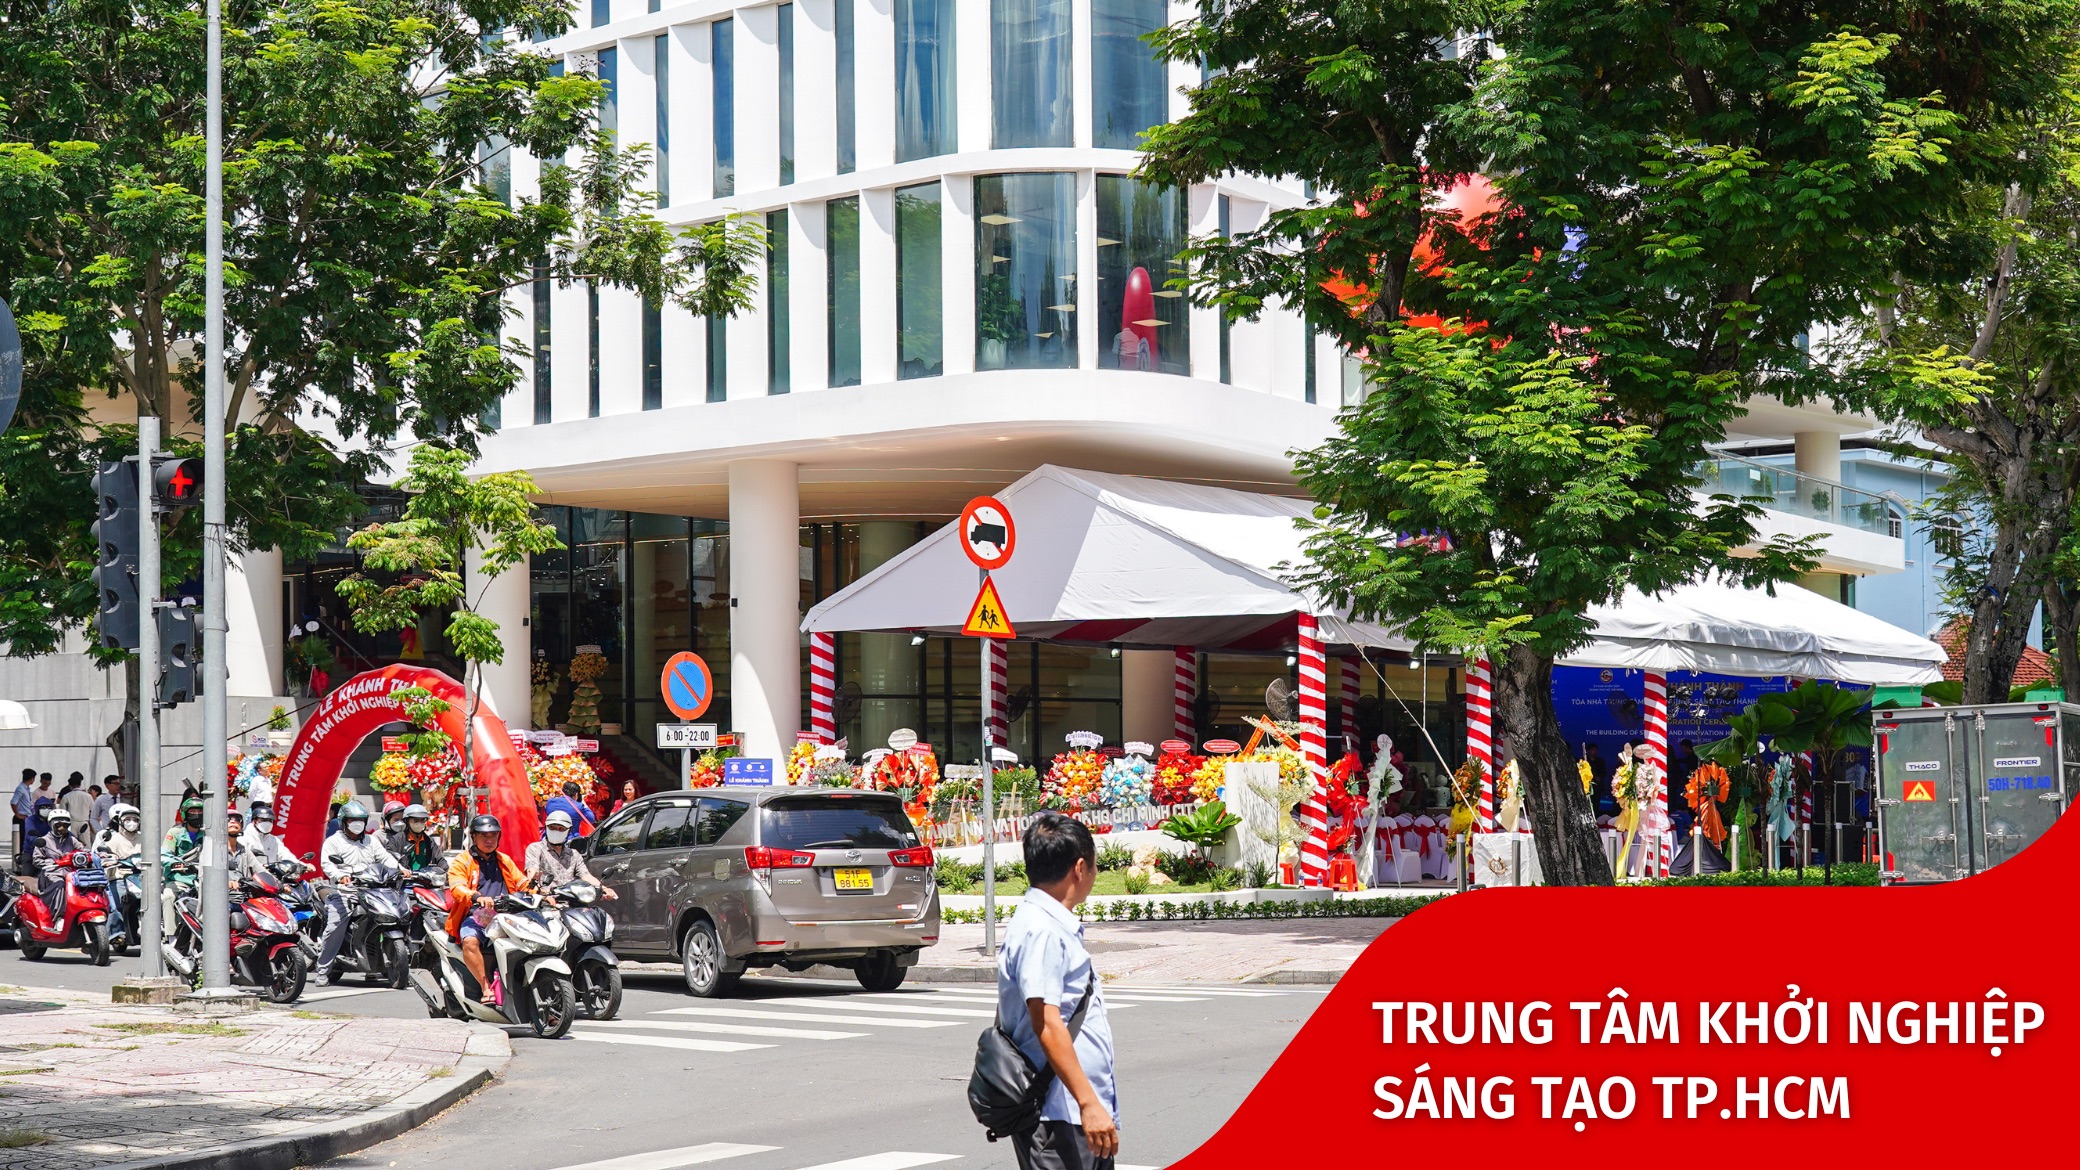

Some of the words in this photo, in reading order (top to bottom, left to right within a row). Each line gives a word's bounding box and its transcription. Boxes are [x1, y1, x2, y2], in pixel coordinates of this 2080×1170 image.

[338, 677, 386, 702] KHÁNH
[286, 741, 315, 788] TRUNG
[310, 716, 335, 744] TÂM
[332, 699, 360, 724] KHỞI
[360, 694, 399, 711] NGHIỆP
[1996, 758, 2038, 766] FRONTIER
[1987, 775, 2051, 792] 50H-718.40
[961, 814, 1039, 838] INNVATION
[1092, 808, 1110, 825] HO
[1112, 806, 1135, 824] CHI
[1137, 803, 1171, 821] MINH
[844, 869, 861, 879] 51F
[839, 879, 870, 888] 881.55
